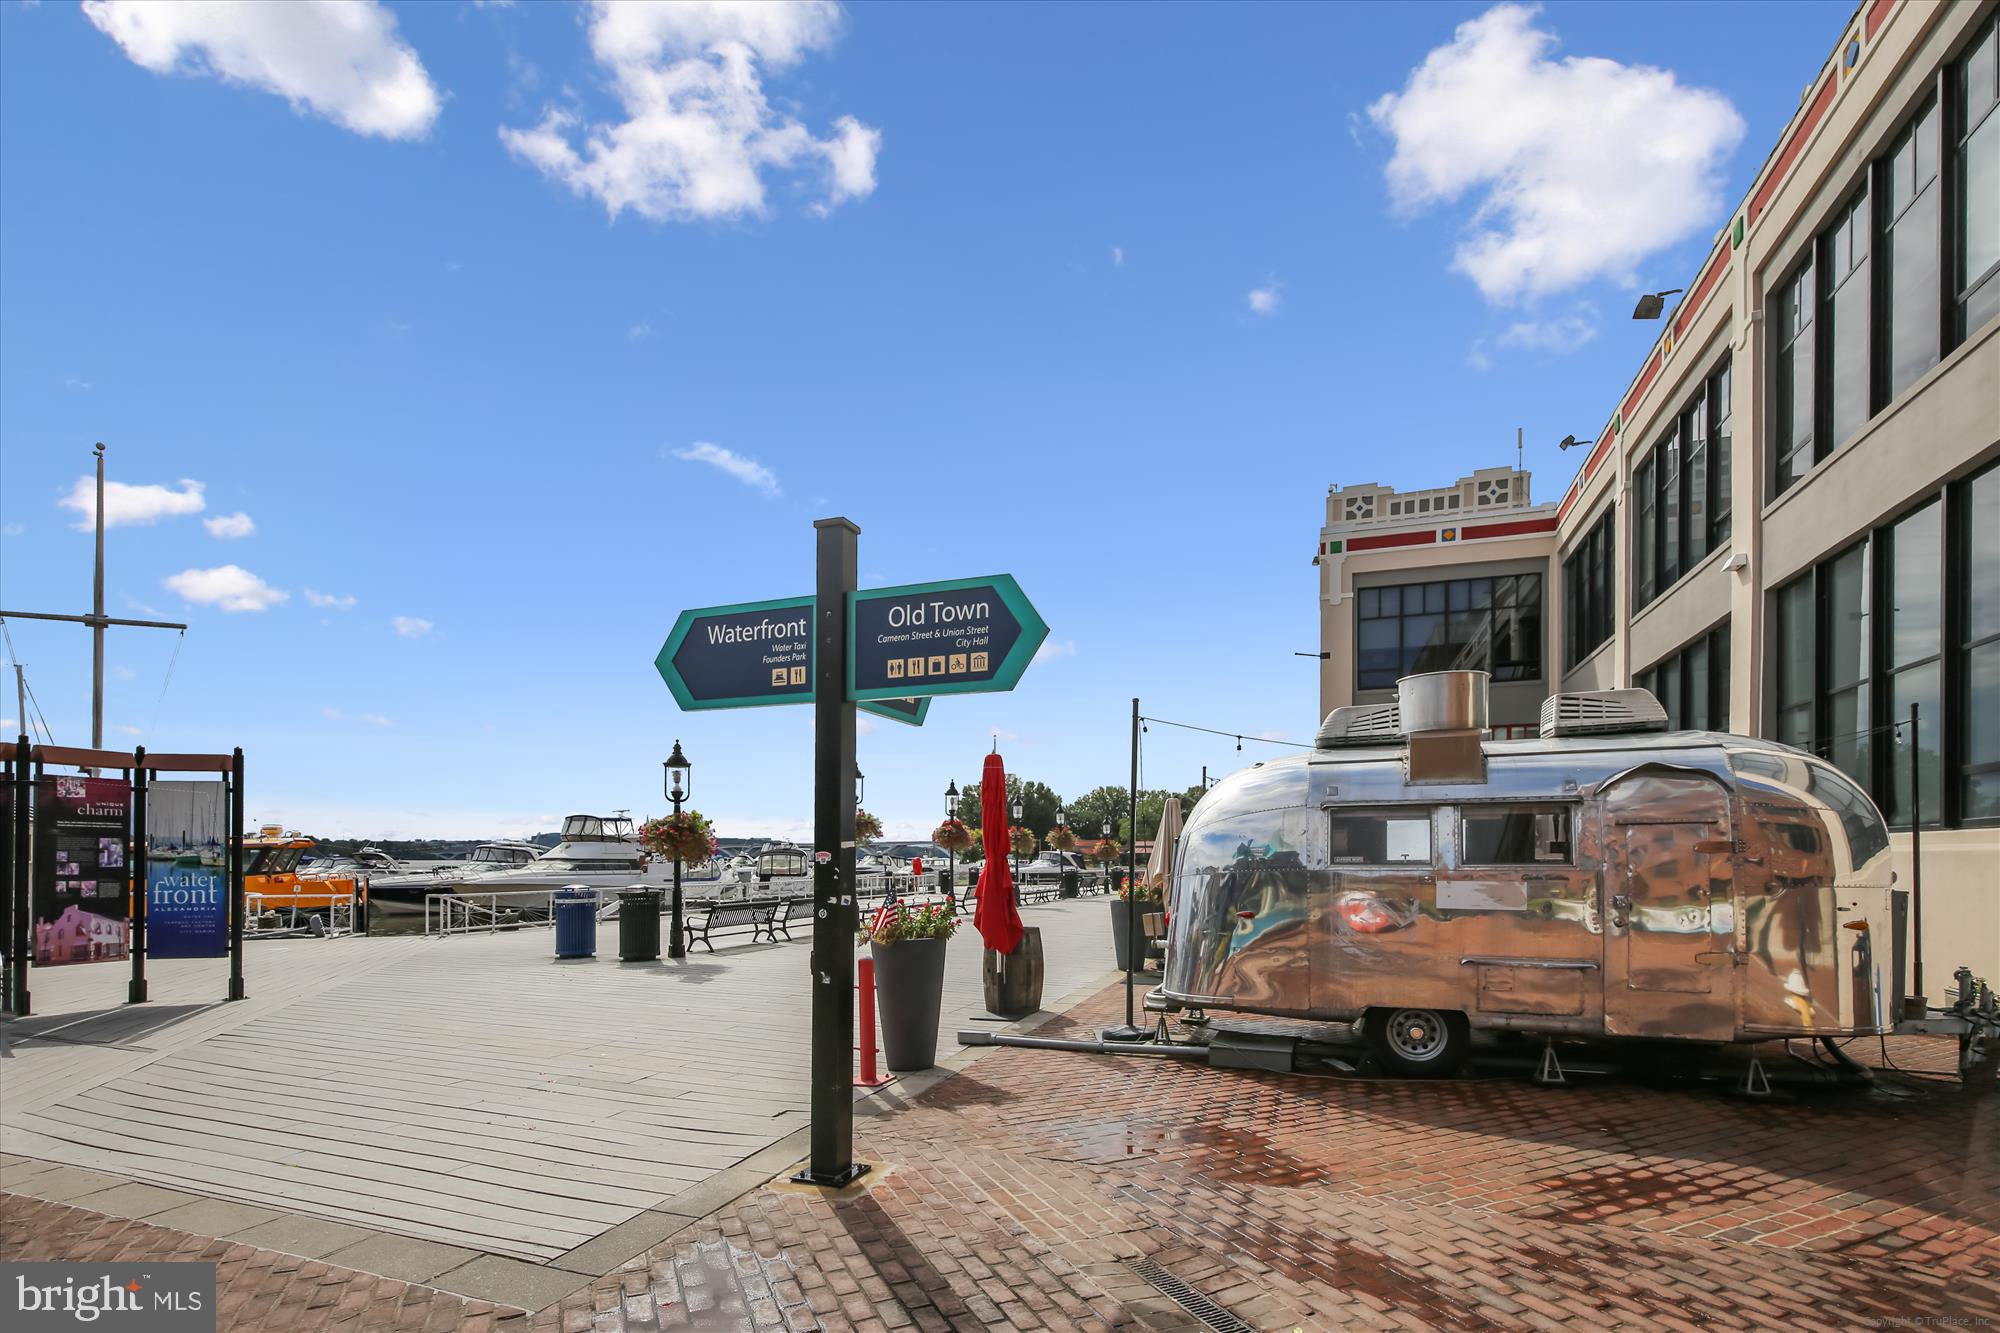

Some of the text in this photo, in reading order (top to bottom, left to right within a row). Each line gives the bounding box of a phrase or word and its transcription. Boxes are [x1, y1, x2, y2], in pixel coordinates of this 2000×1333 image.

[888, 601, 989, 628] Old Town
[707, 618, 807, 645] Waterfront
[877, 625, 989, 644] Cameron Street & Union Street
[771, 641, 807, 653] Water Taxi
[955, 636, 989, 649] City Hall
[762, 652, 807, 664] Founders Park
[77, 803, 123, 817] charm
[163, 872, 217, 887] water
[152, 880, 218, 905] front
